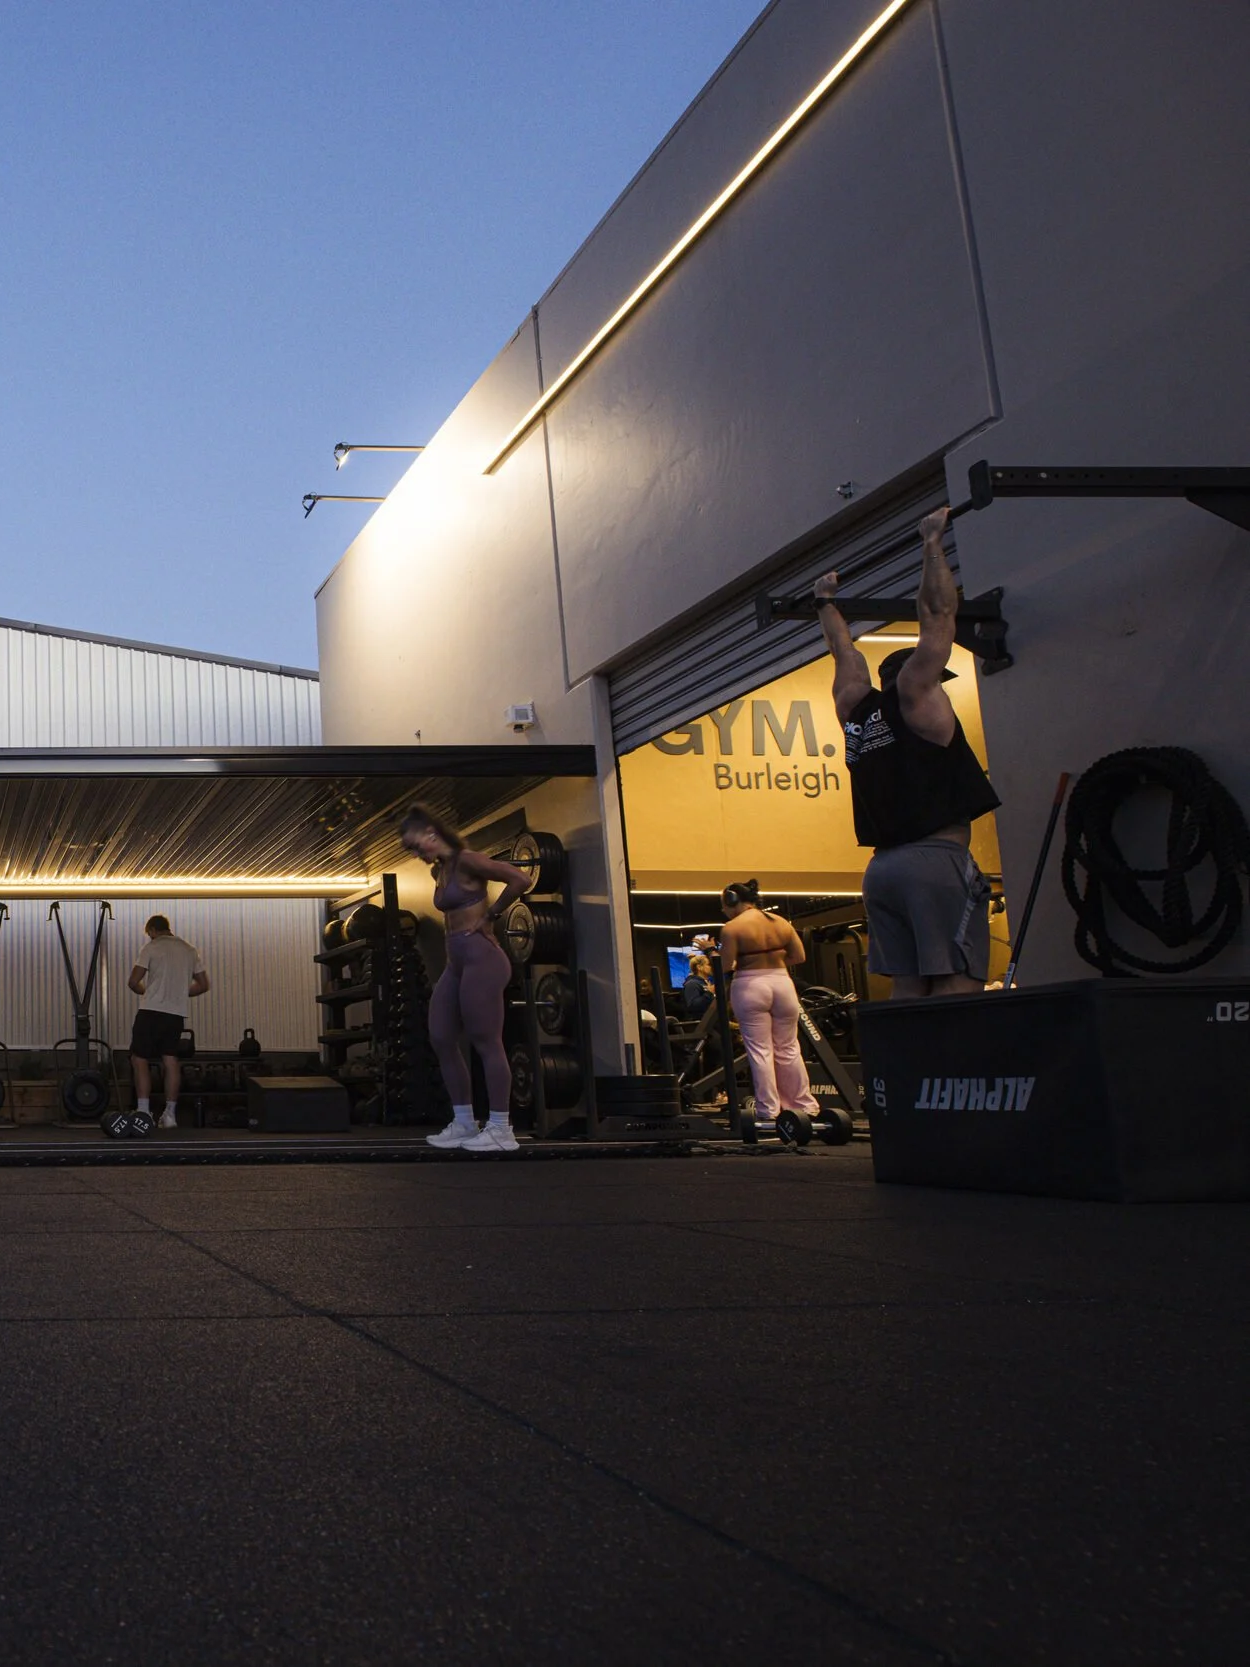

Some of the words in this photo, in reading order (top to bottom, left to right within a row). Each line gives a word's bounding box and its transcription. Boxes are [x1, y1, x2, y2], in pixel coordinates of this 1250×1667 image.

[714, 763, 839, 798] Burleigh
[914, 1077, 1036, 1111] ALPHAFIT
[113, 1119, 128, 1134] 17.5
[134, 1117, 150, 1130] 17.5
